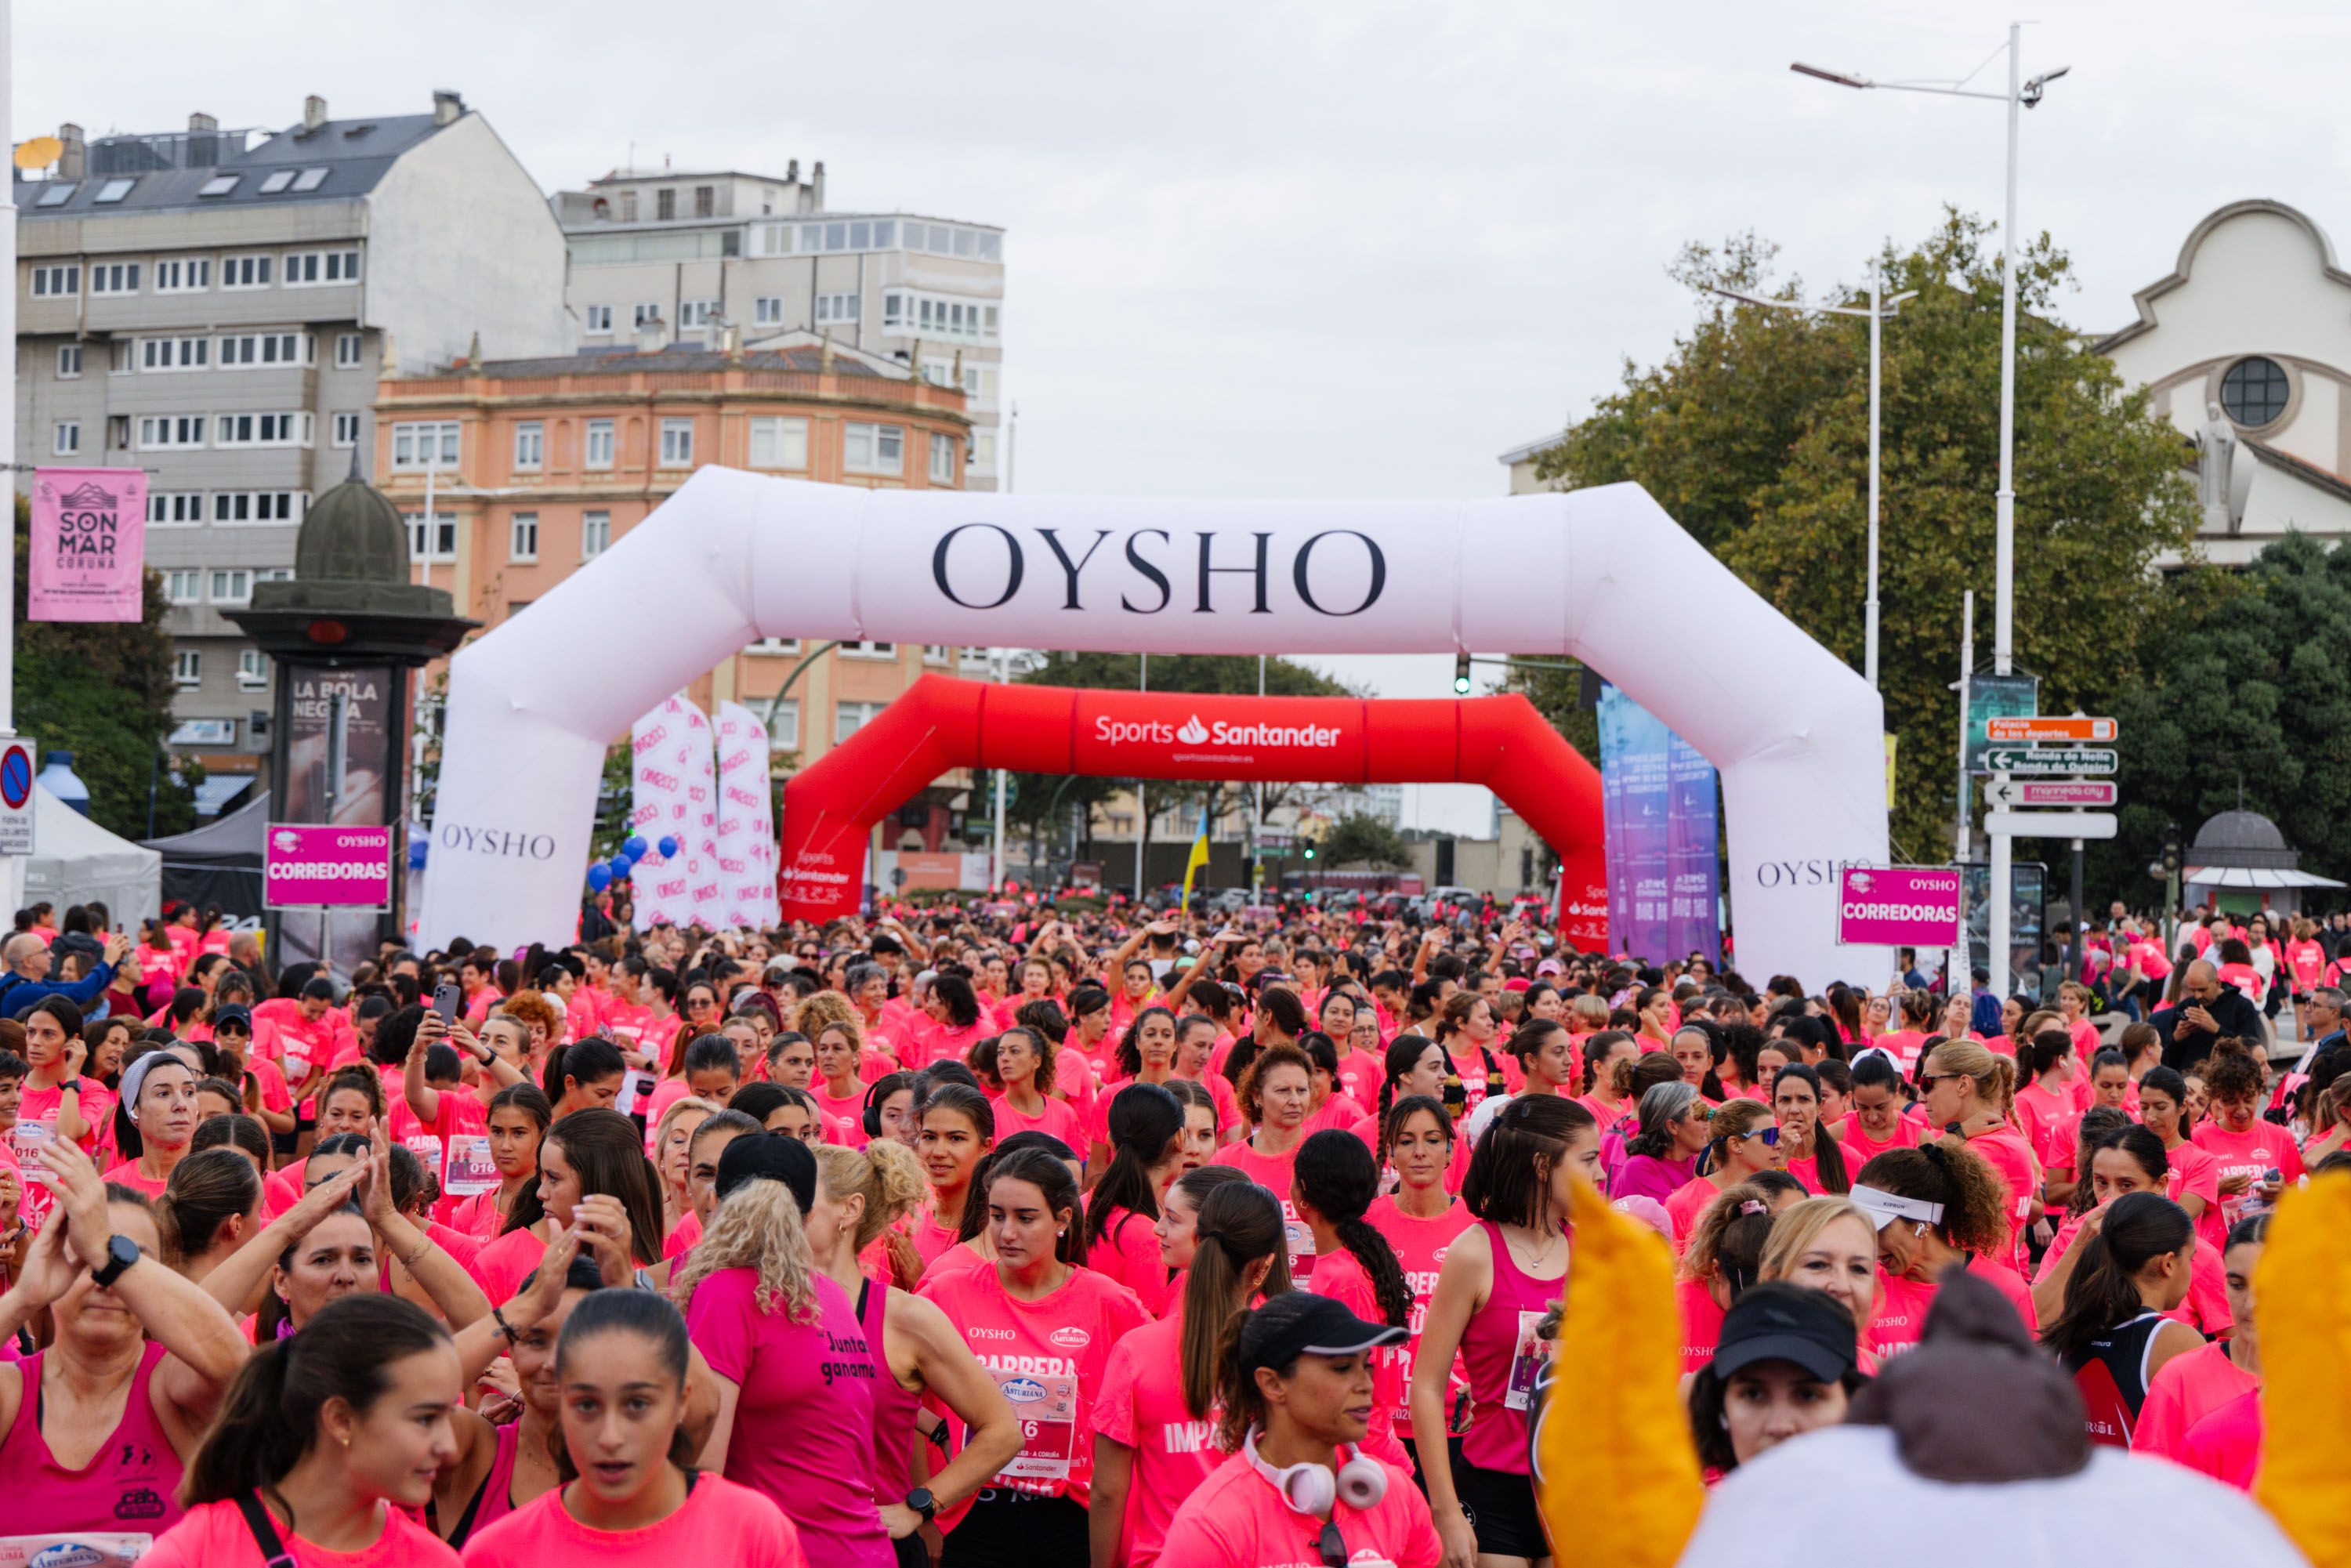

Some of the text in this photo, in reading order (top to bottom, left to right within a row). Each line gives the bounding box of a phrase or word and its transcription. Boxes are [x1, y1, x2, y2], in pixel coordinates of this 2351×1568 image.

[60, 512, 117, 533] SON
[932, 523, 1387, 617] OYSHO
[294, 681, 378, 701] LA BOLA
[292, 701, 361, 719] NEGA
[1095, 715, 1342, 747] Sports Santander
[1993, 719, 2030, 729] Palacio
[1993, 729, 2070, 740] de los deportes
[2026, 751, 2062, 761] Ronda
[2063, 751, 2078, 760] de
[2013, 762, 2111, 772] Ronda de Outeiro
[2084, 786, 2104, 798] city
[336, 835, 387, 848] OYSHO
[442, 823, 555, 860] OYSHO
[268, 862, 387, 880] CORREDORAS
[793, 867, 850, 885] Santander
[1585, 884, 1607, 900] Spo
[1909, 878, 1957, 892] OYSHO
[1581, 903, 1608, 917] Sant
[1842, 902, 1958, 923] CORREDORAS
[15, 1147, 38, 1157] 016
[470, 1162, 496, 1173] 016
[1882, 1201, 1906, 1210] KIPRUN
[2016, 1196, 2032, 1216] IM
[969, 1327, 1016, 1340] OYSHO
[1054, 1334, 1087, 1343] ASTURIANA
[821, 1362, 878, 1385] ganamo
[1003, 1385, 1044, 1398] ASTURIANA
[1164, 1420, 1223, 1454] IMPA
[1038, 1450, 1060, 1458] CORUÑA
[1024, 1464, 1057, 1472] Santander
[121, 1487, 158, 1505] cab
[0, 1551, 24, 1561] UMA
